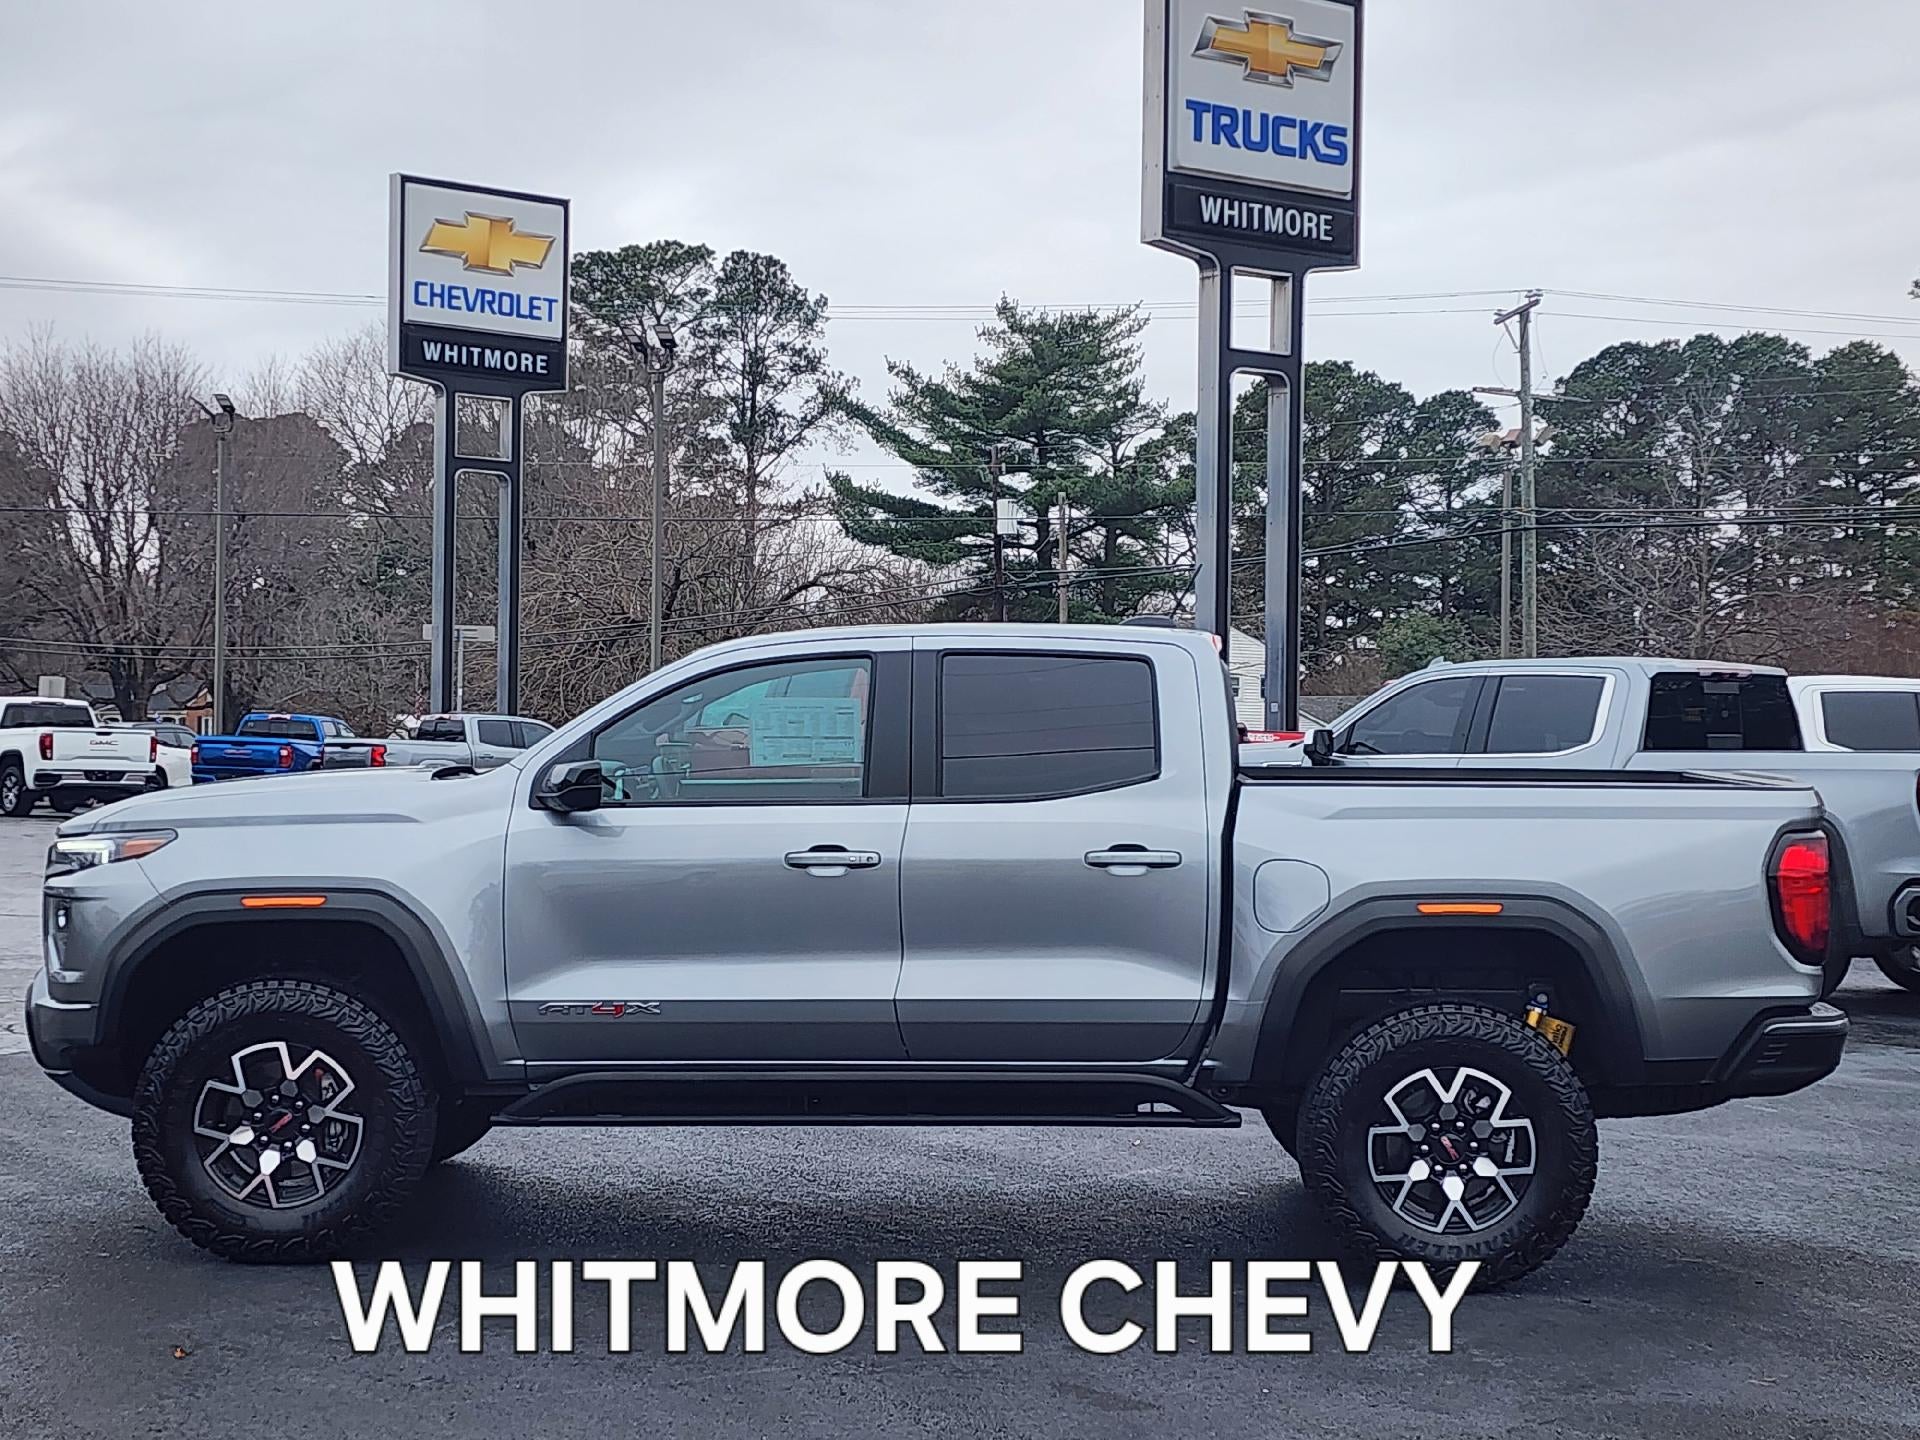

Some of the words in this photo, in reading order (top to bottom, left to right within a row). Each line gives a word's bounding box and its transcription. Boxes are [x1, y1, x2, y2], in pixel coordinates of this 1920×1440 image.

[1185, 99, 1348, 166] TRUCKS
[1199, 194, 1334, 242] WHITMORE
[413, 280, 559, 323] CHEVROLET
[422, 339, 550, 375] WHITMORE
